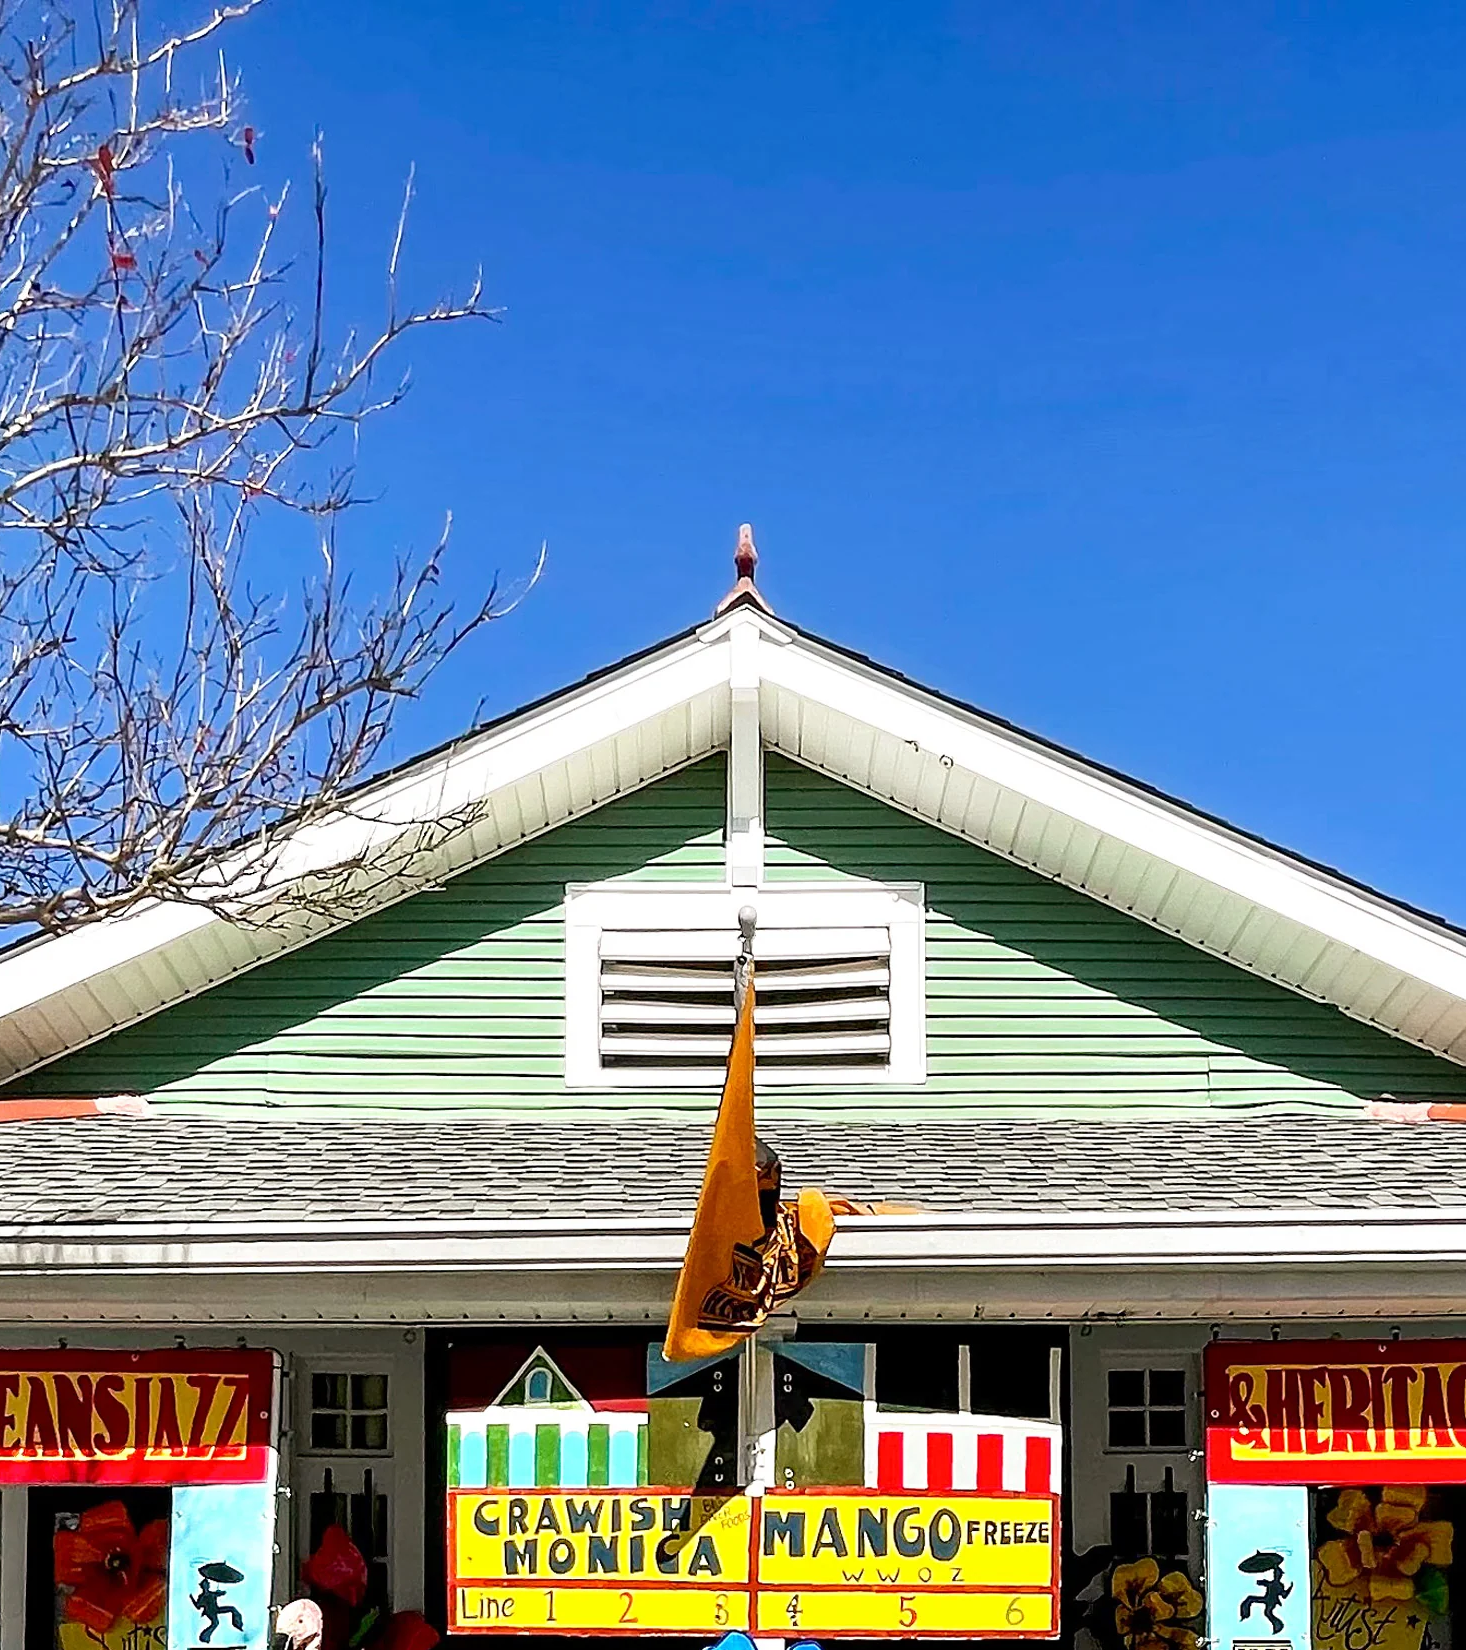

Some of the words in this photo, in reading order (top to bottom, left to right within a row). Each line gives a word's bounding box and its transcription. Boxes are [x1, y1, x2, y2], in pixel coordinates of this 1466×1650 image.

[473, 1497, 692, 1536] CRAWISH
[762, 1506, 962, 1562] MANGO
[966, 1519, 1050, 1546] FREEZE
[503, 1533, 723, 1577] MONICA
[460, 1587, 515, 1620] Line
[543, 1589, 558, 1622] 1
[617, 1591, 639, 1624] 2
[713, 1593, 730, 1626] 3
[785, 1594, 804, 1628] 4
[898, 1595, 918, 1628] 5
[1004, 1596, 1025, 1627] 6
